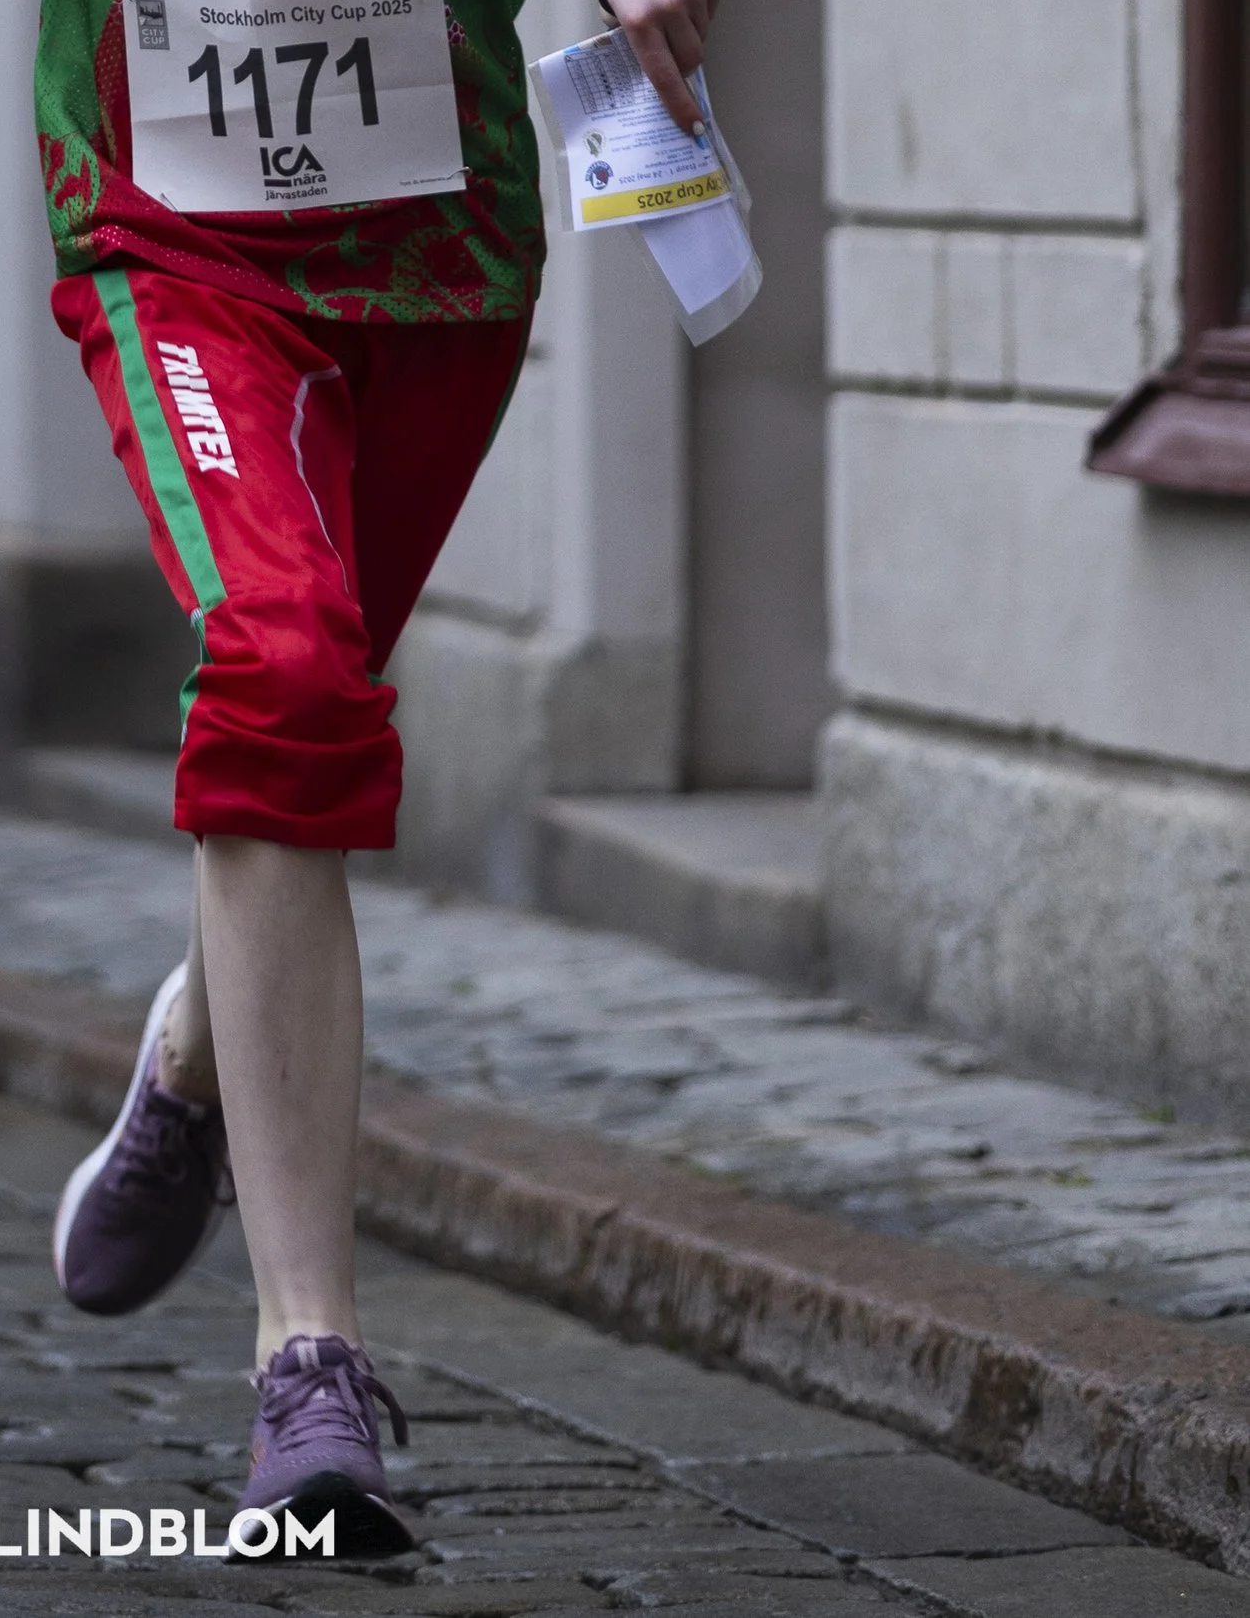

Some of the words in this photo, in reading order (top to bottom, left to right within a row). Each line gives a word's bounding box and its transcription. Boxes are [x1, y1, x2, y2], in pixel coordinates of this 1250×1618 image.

[200, 6, 286, 26] Stockholm
[291, 6, 325, 25] City
[331, 4, 366, 22] Cup
[141, 28, 165, 36] CITY
[142, 36, 165, 45] CUP
[188, 37, 379, 138] 1171
[260, 143, 325, 177] ICA
[293, 173, 327, 186] nära
[265, 186, 328, 201] Järvastaden
[637, 190, 674, 209] 2025
[677, 184, 704, 198] Cup
[157, 341, 240, 479] TRIMTEX
